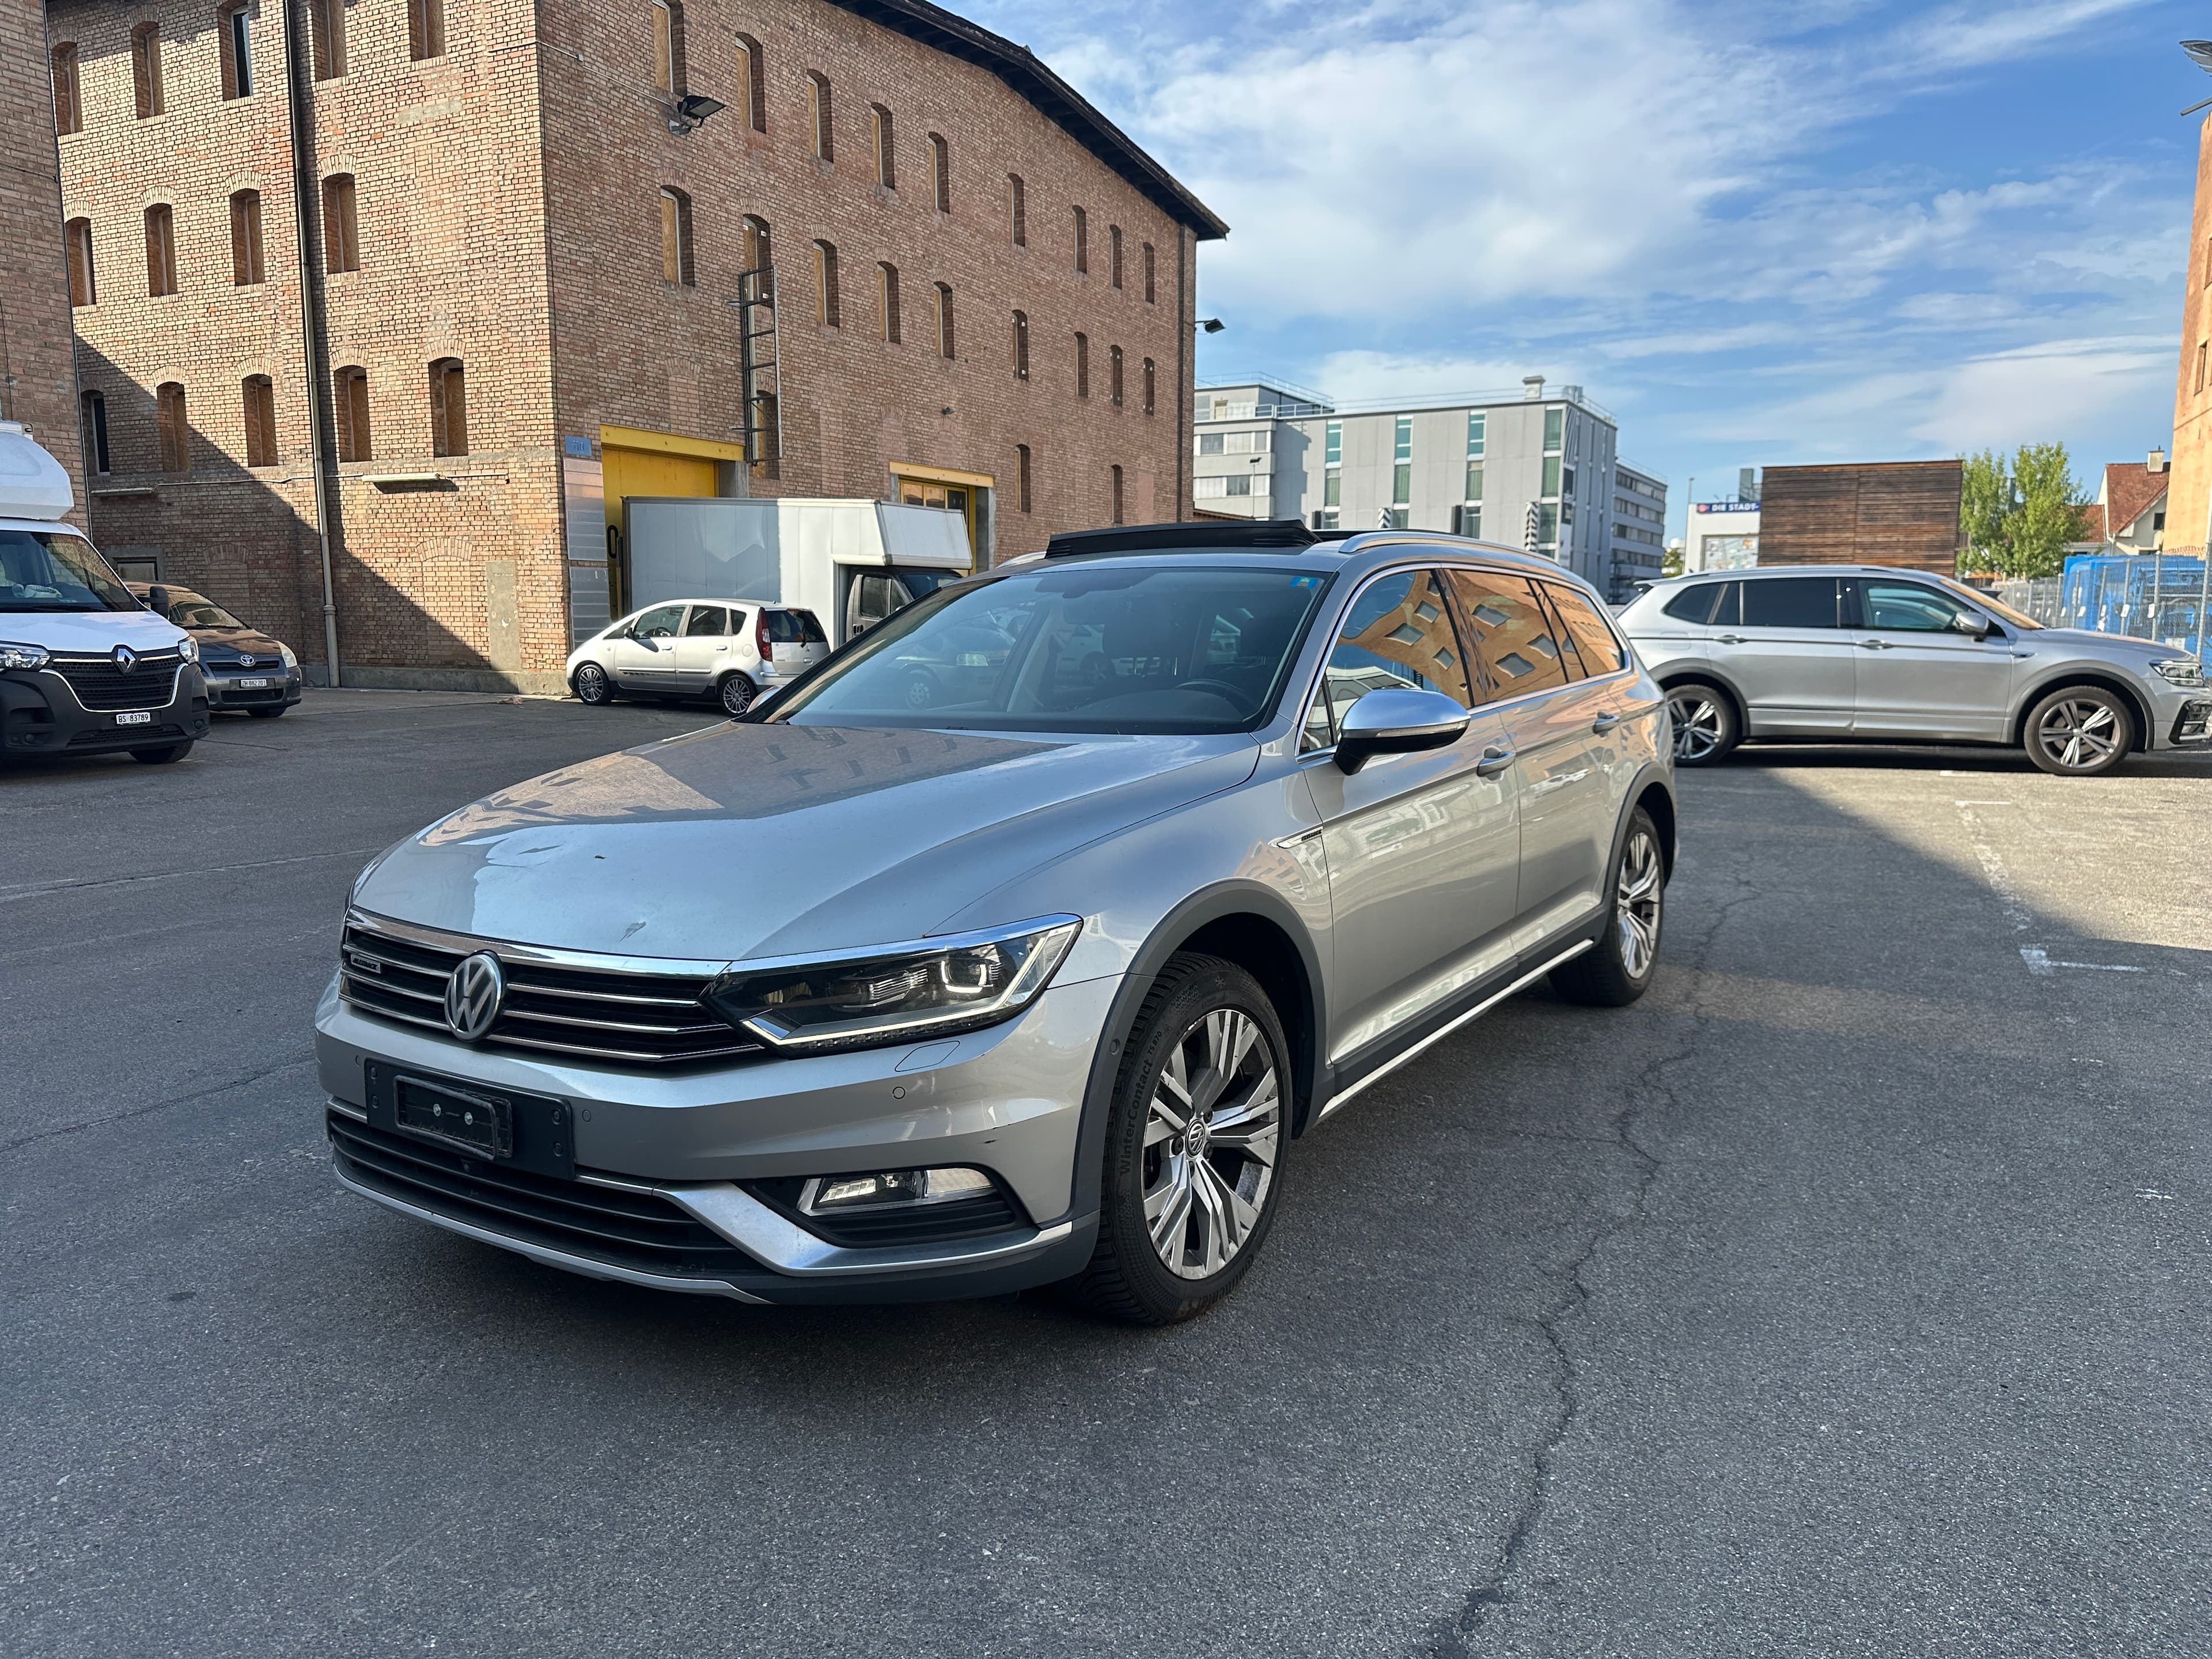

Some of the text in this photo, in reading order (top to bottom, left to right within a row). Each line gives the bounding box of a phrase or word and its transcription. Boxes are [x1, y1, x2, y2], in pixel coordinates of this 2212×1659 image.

[1711, 503, 1726, 512] DIE
[130, 714, 148, 722] 83789
[1119, 1059, 1153, 1177] WinterContact
